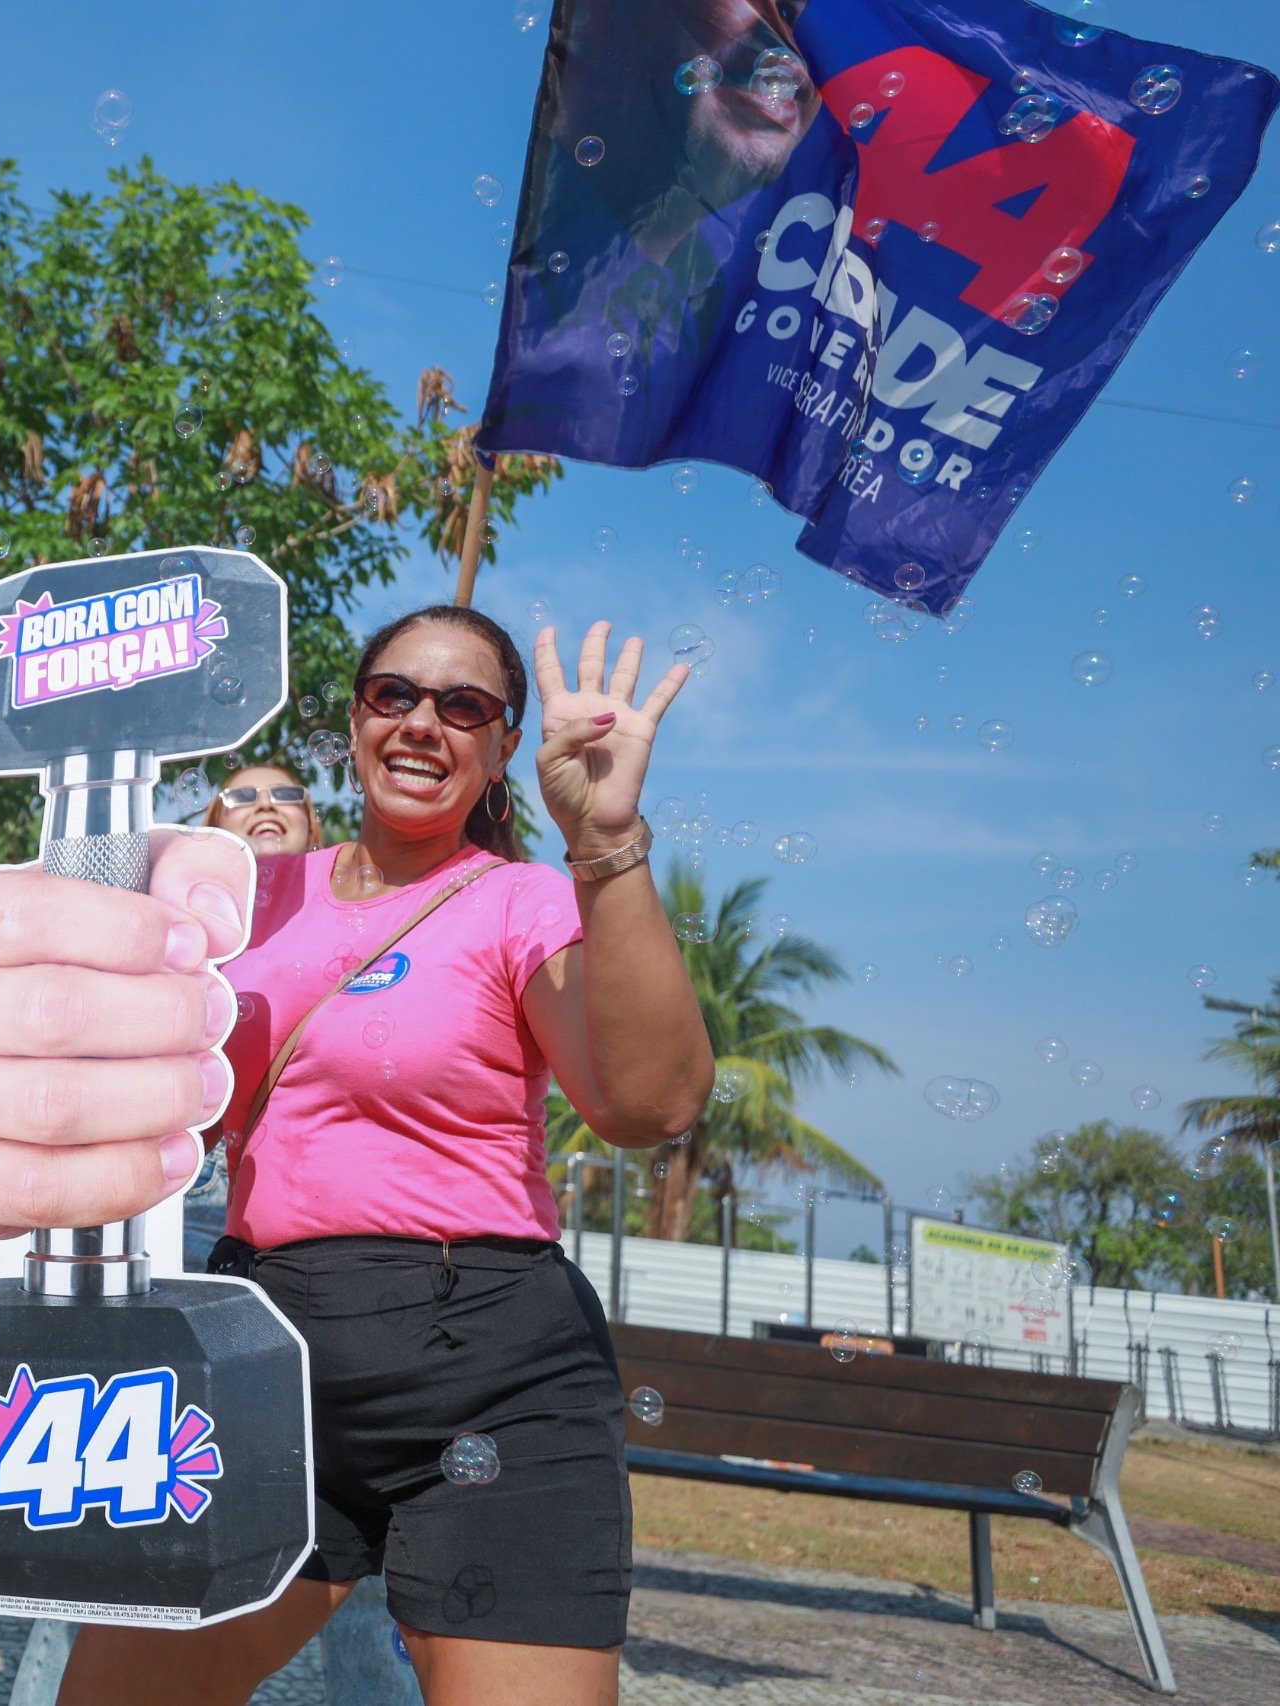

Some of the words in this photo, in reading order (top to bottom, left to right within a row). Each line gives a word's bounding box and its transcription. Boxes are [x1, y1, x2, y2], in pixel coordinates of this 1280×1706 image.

[821, 45, 1136, 325] 44
[766, 362, 799, 391] VICE
[21, 599, 109, 653] BORA
[114, 581, 195, 631] COM
[24, 621, 190, 699] FORÇA!
